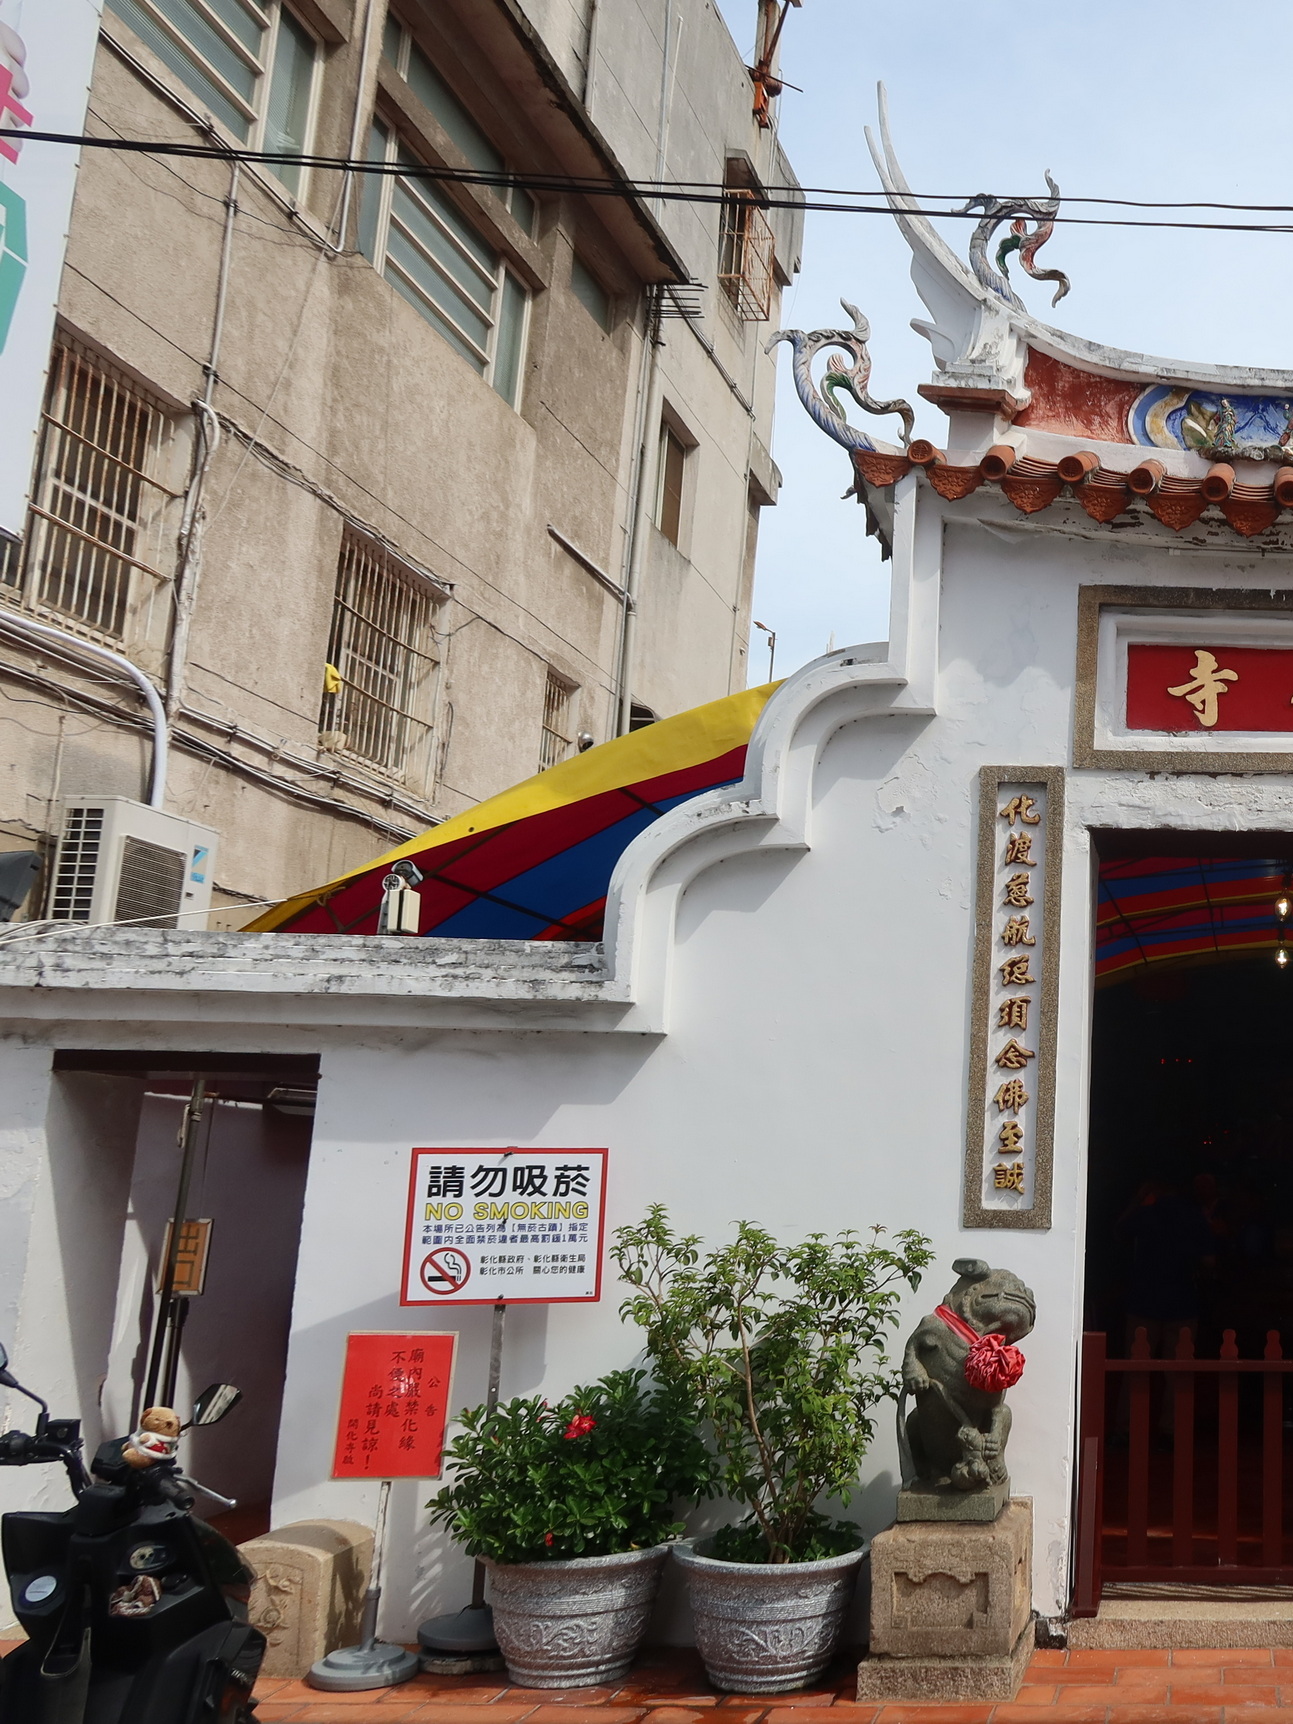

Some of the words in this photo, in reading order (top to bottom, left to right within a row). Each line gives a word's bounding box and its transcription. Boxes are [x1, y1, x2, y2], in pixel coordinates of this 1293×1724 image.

[427, 1164, 590, 1198] 請勿吸菸
[424, 1202, 464, 1221] NO
[473, 1201, 589, 1221] SMOKING
